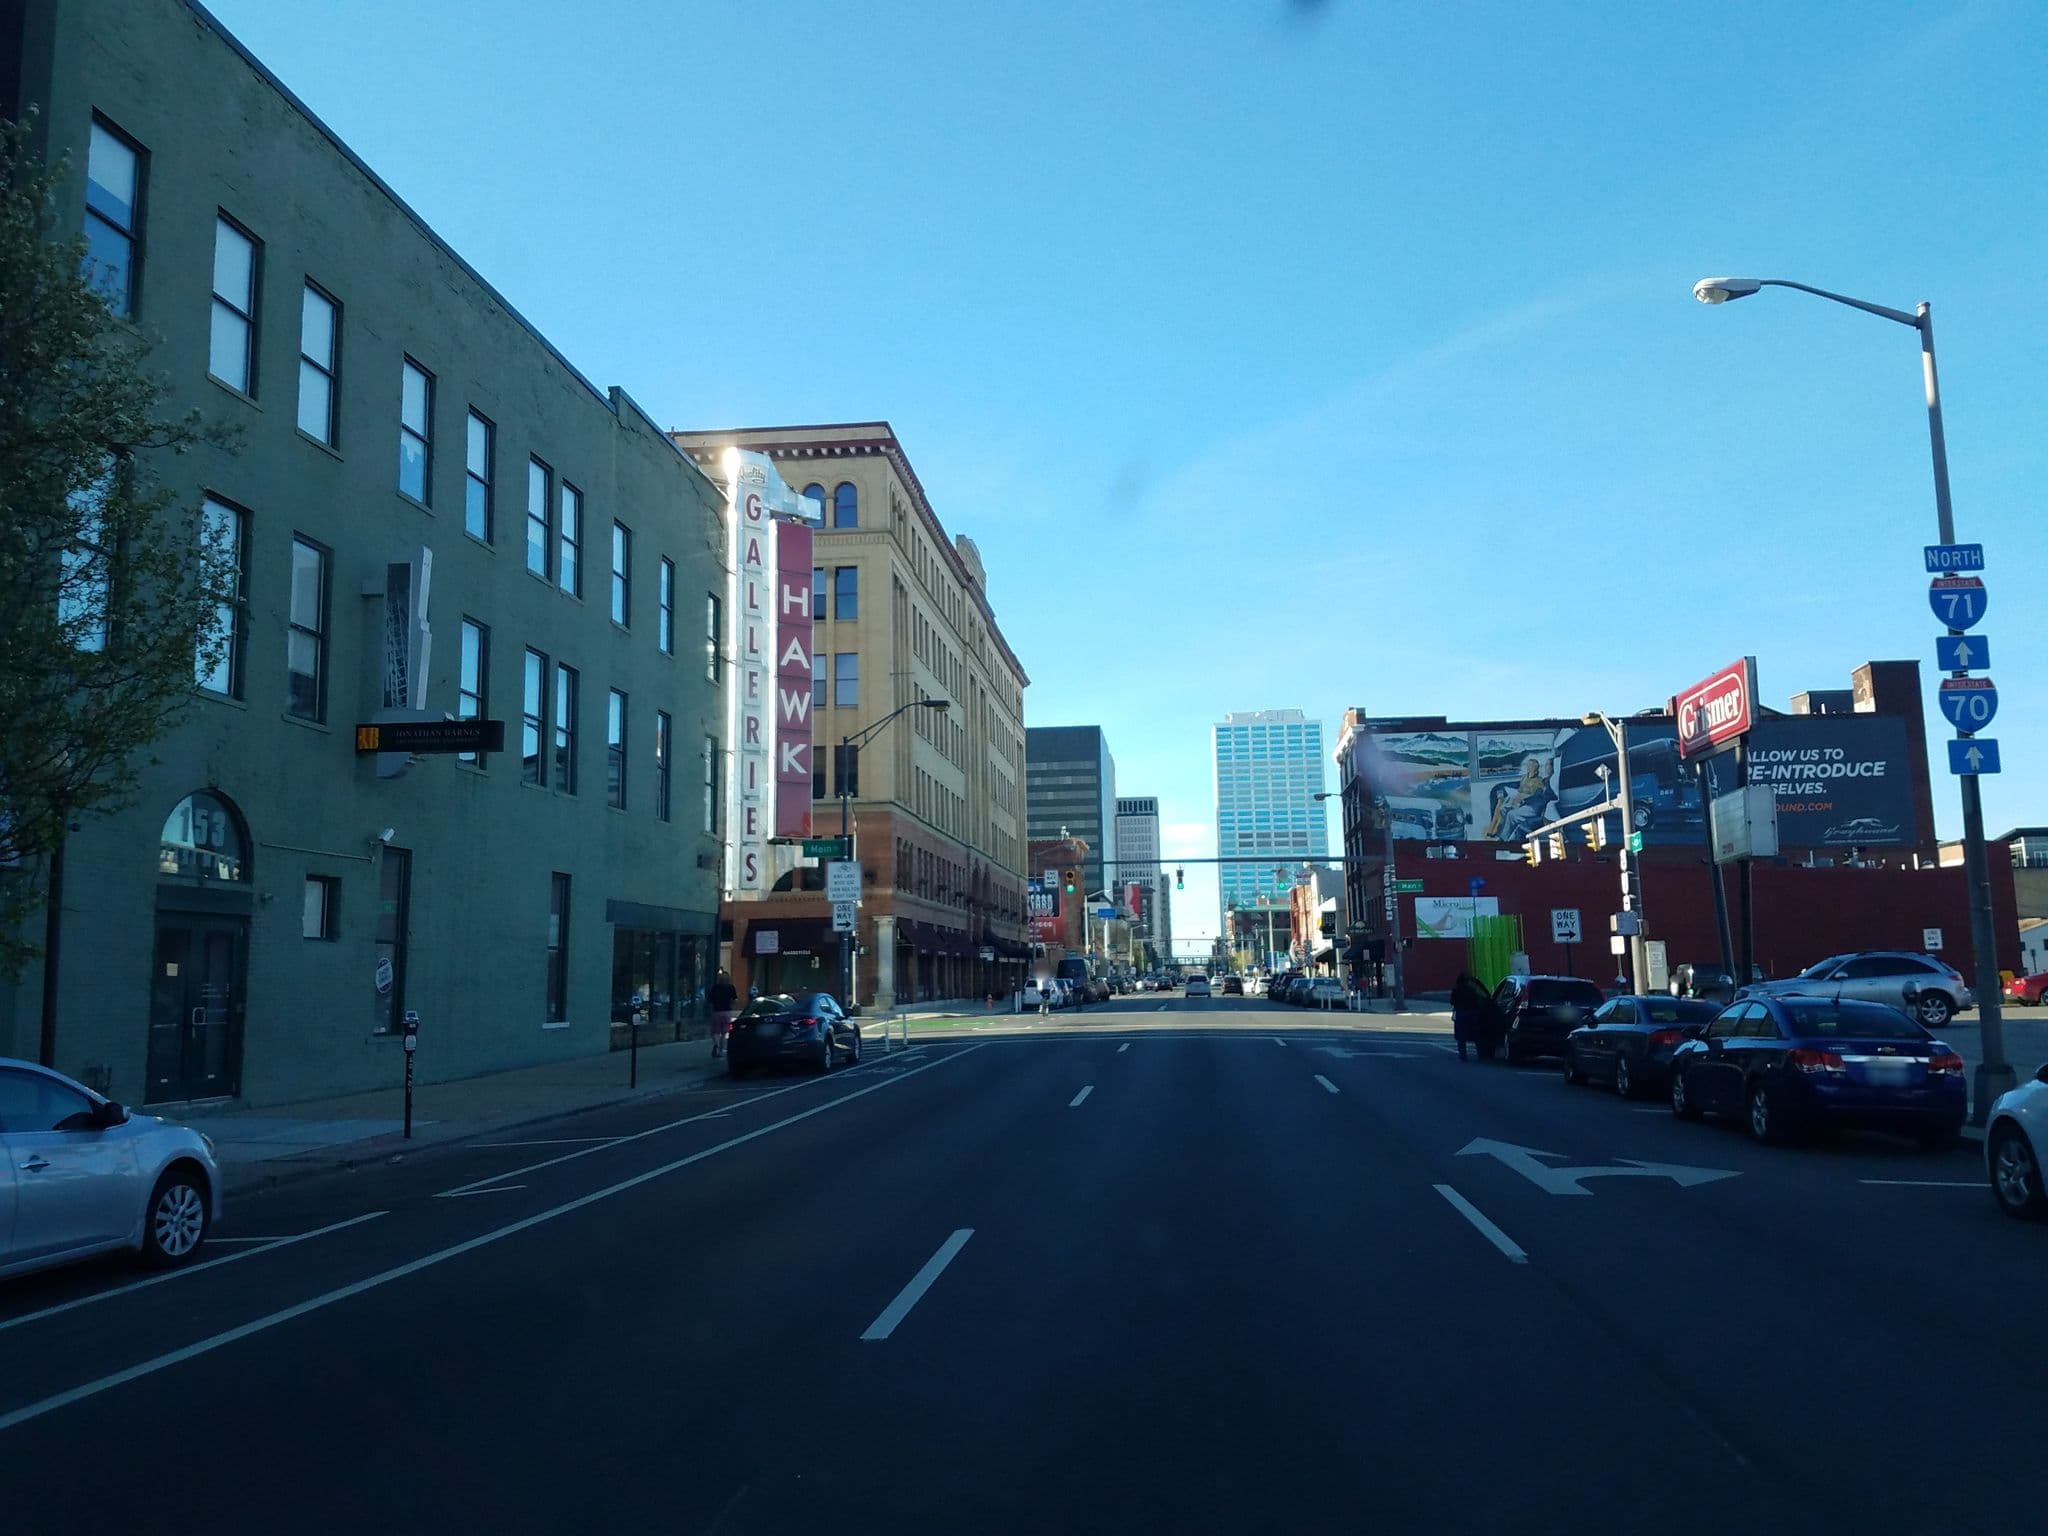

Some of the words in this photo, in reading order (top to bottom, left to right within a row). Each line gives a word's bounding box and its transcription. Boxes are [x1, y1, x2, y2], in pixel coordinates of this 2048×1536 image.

[1927, 550, 1982, 568] NORTH
[1941, 593, 1973, 619] 71
[745, 493, 762, 882] GALLERIES
[781, 584, 811, 774] HAWK
[1681, 688, 1740, 739] Grismer
[1948, 695, 1989, 721] 70
[1799, 749, 1819, 762] US
[1823, 748, 1845, 760] TO
[837, 904, 852, 912] ONE
[1556, 911, 1576, 920] ONE
[1557, 920, 1576, 929] WAY
